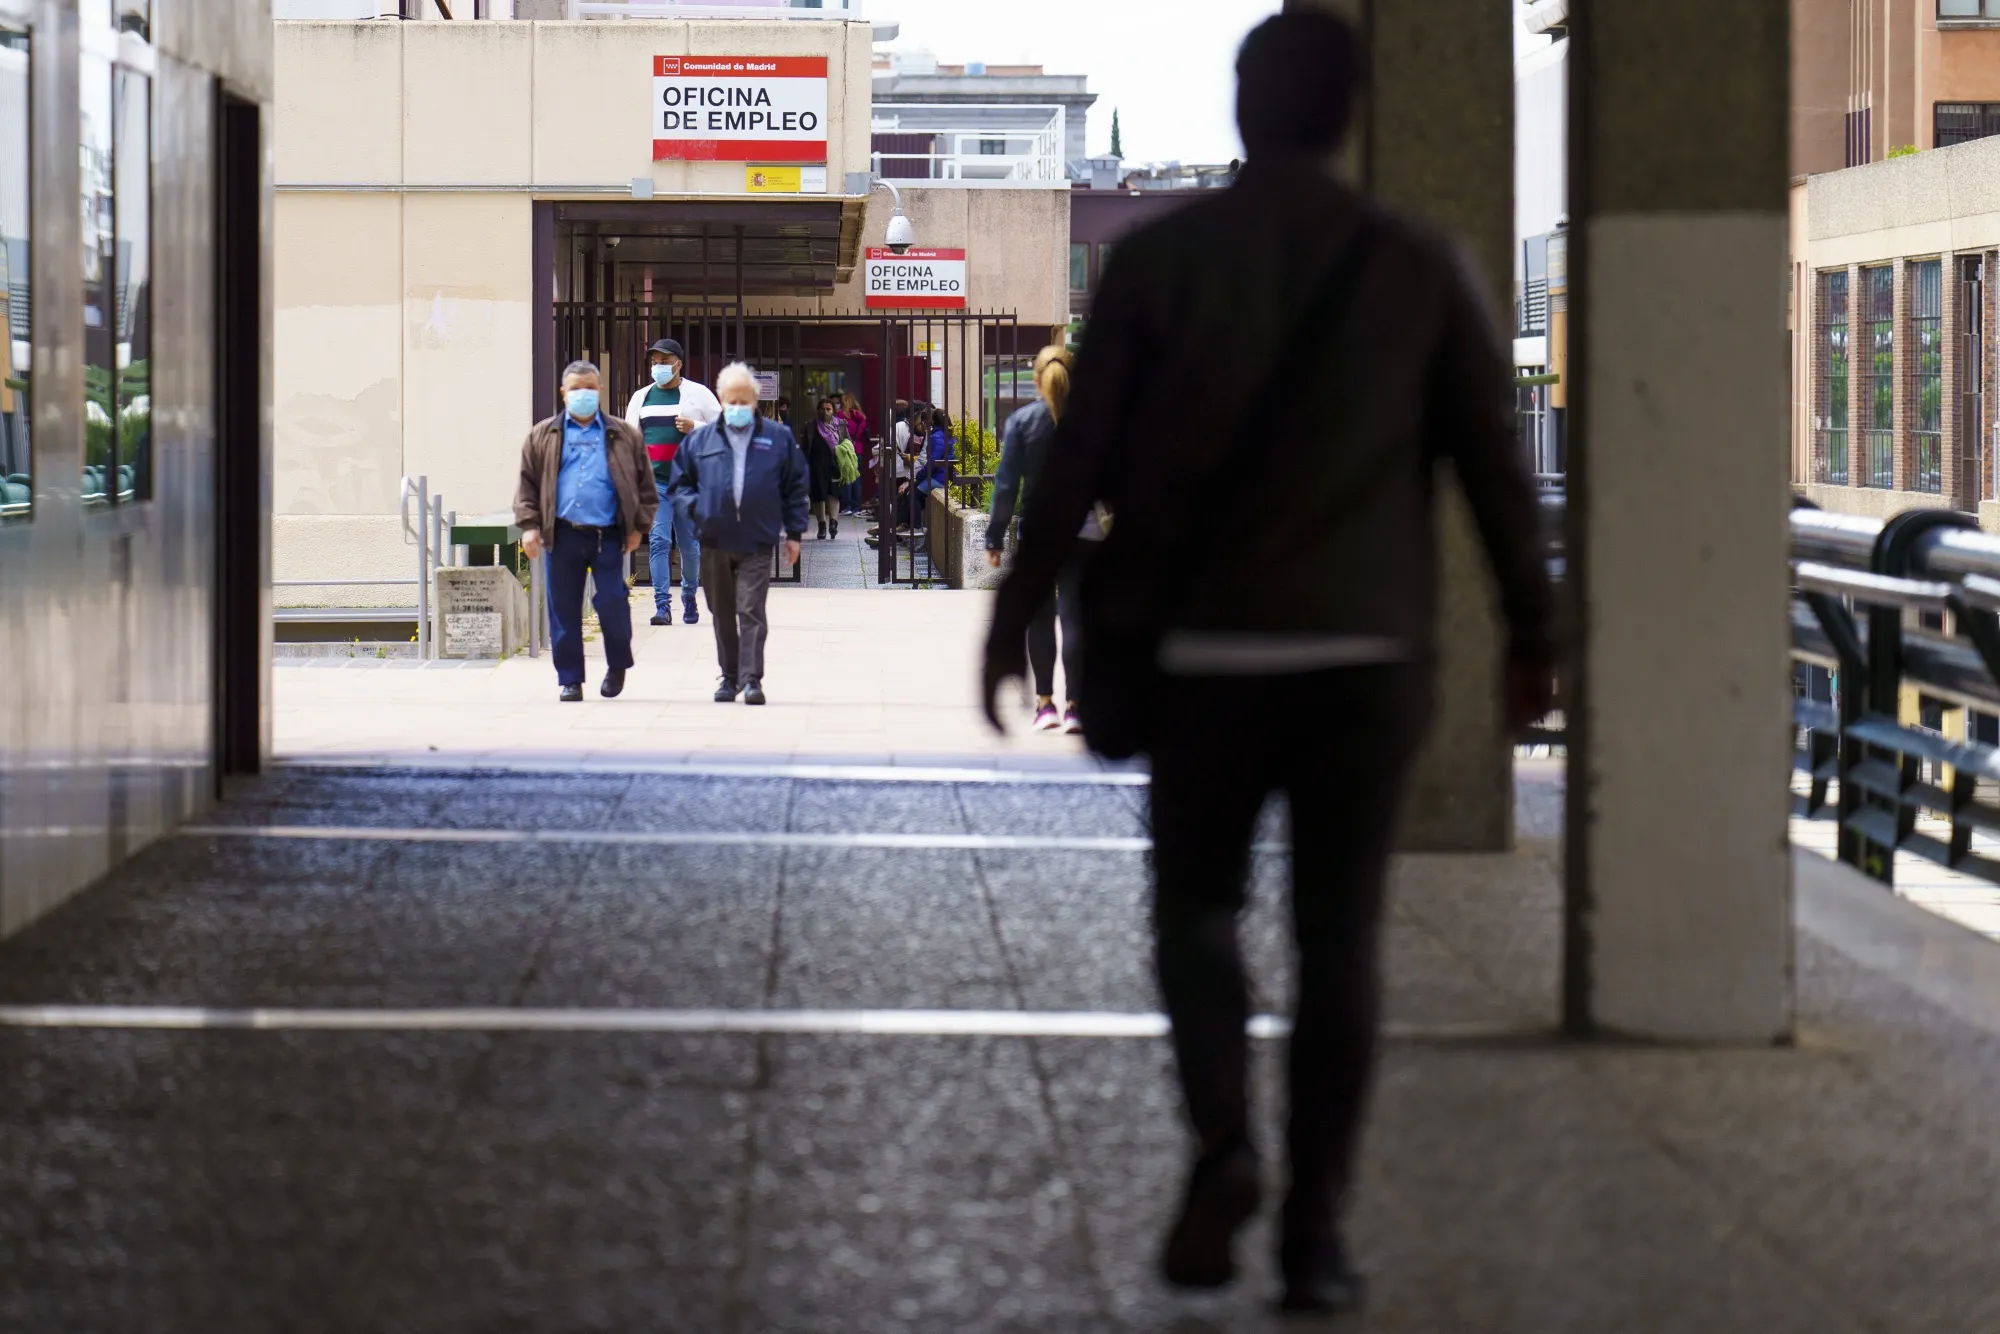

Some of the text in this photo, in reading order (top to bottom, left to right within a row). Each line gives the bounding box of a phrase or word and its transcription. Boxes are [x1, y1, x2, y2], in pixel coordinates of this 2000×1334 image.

[683, 62, 776, 71] Comunidad de Madrid
[663, 86, 772, 107] OFICINA
[663, 111, 818, 131] DE EMPLEO
[871, 265, 933, 277] OFICINA
[871, 279, 960, 291] DE EMPLEO
